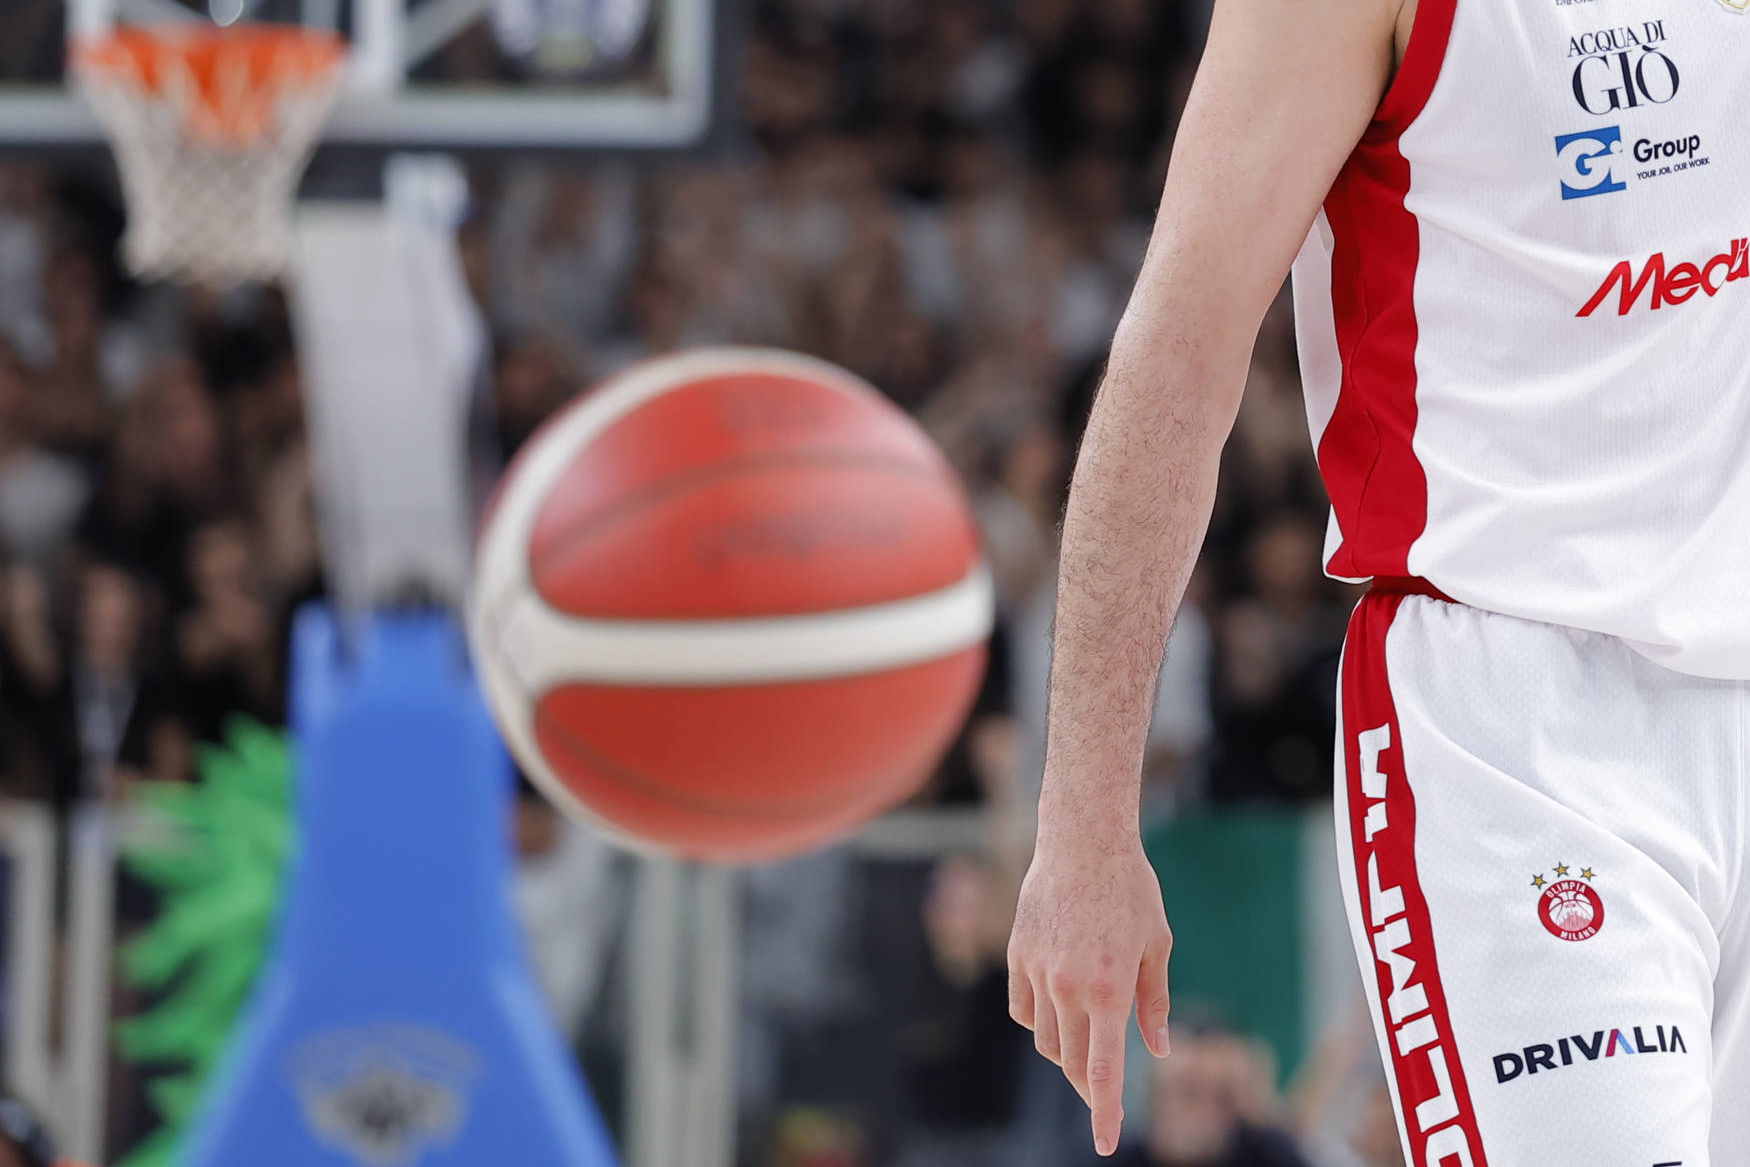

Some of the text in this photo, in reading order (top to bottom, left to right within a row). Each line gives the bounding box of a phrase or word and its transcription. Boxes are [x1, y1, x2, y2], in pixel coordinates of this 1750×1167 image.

[1567, 19, 1668, 57] ACQUA DI
[1572, 44, 1680, 115] GIÒ
[1633, 134, 1700, 163] Group
[1637, 169, 1657, 180] YOUR
[1674, 162, 1687, 172] OUR
[1688, 157, 1710, 168] WORK
[1546, 882, 1586, 899] OLIMPIA
[1560, 925, 1596, 942] MILANO
[1493, 1025, 1687, 1084] DRIVALIA
